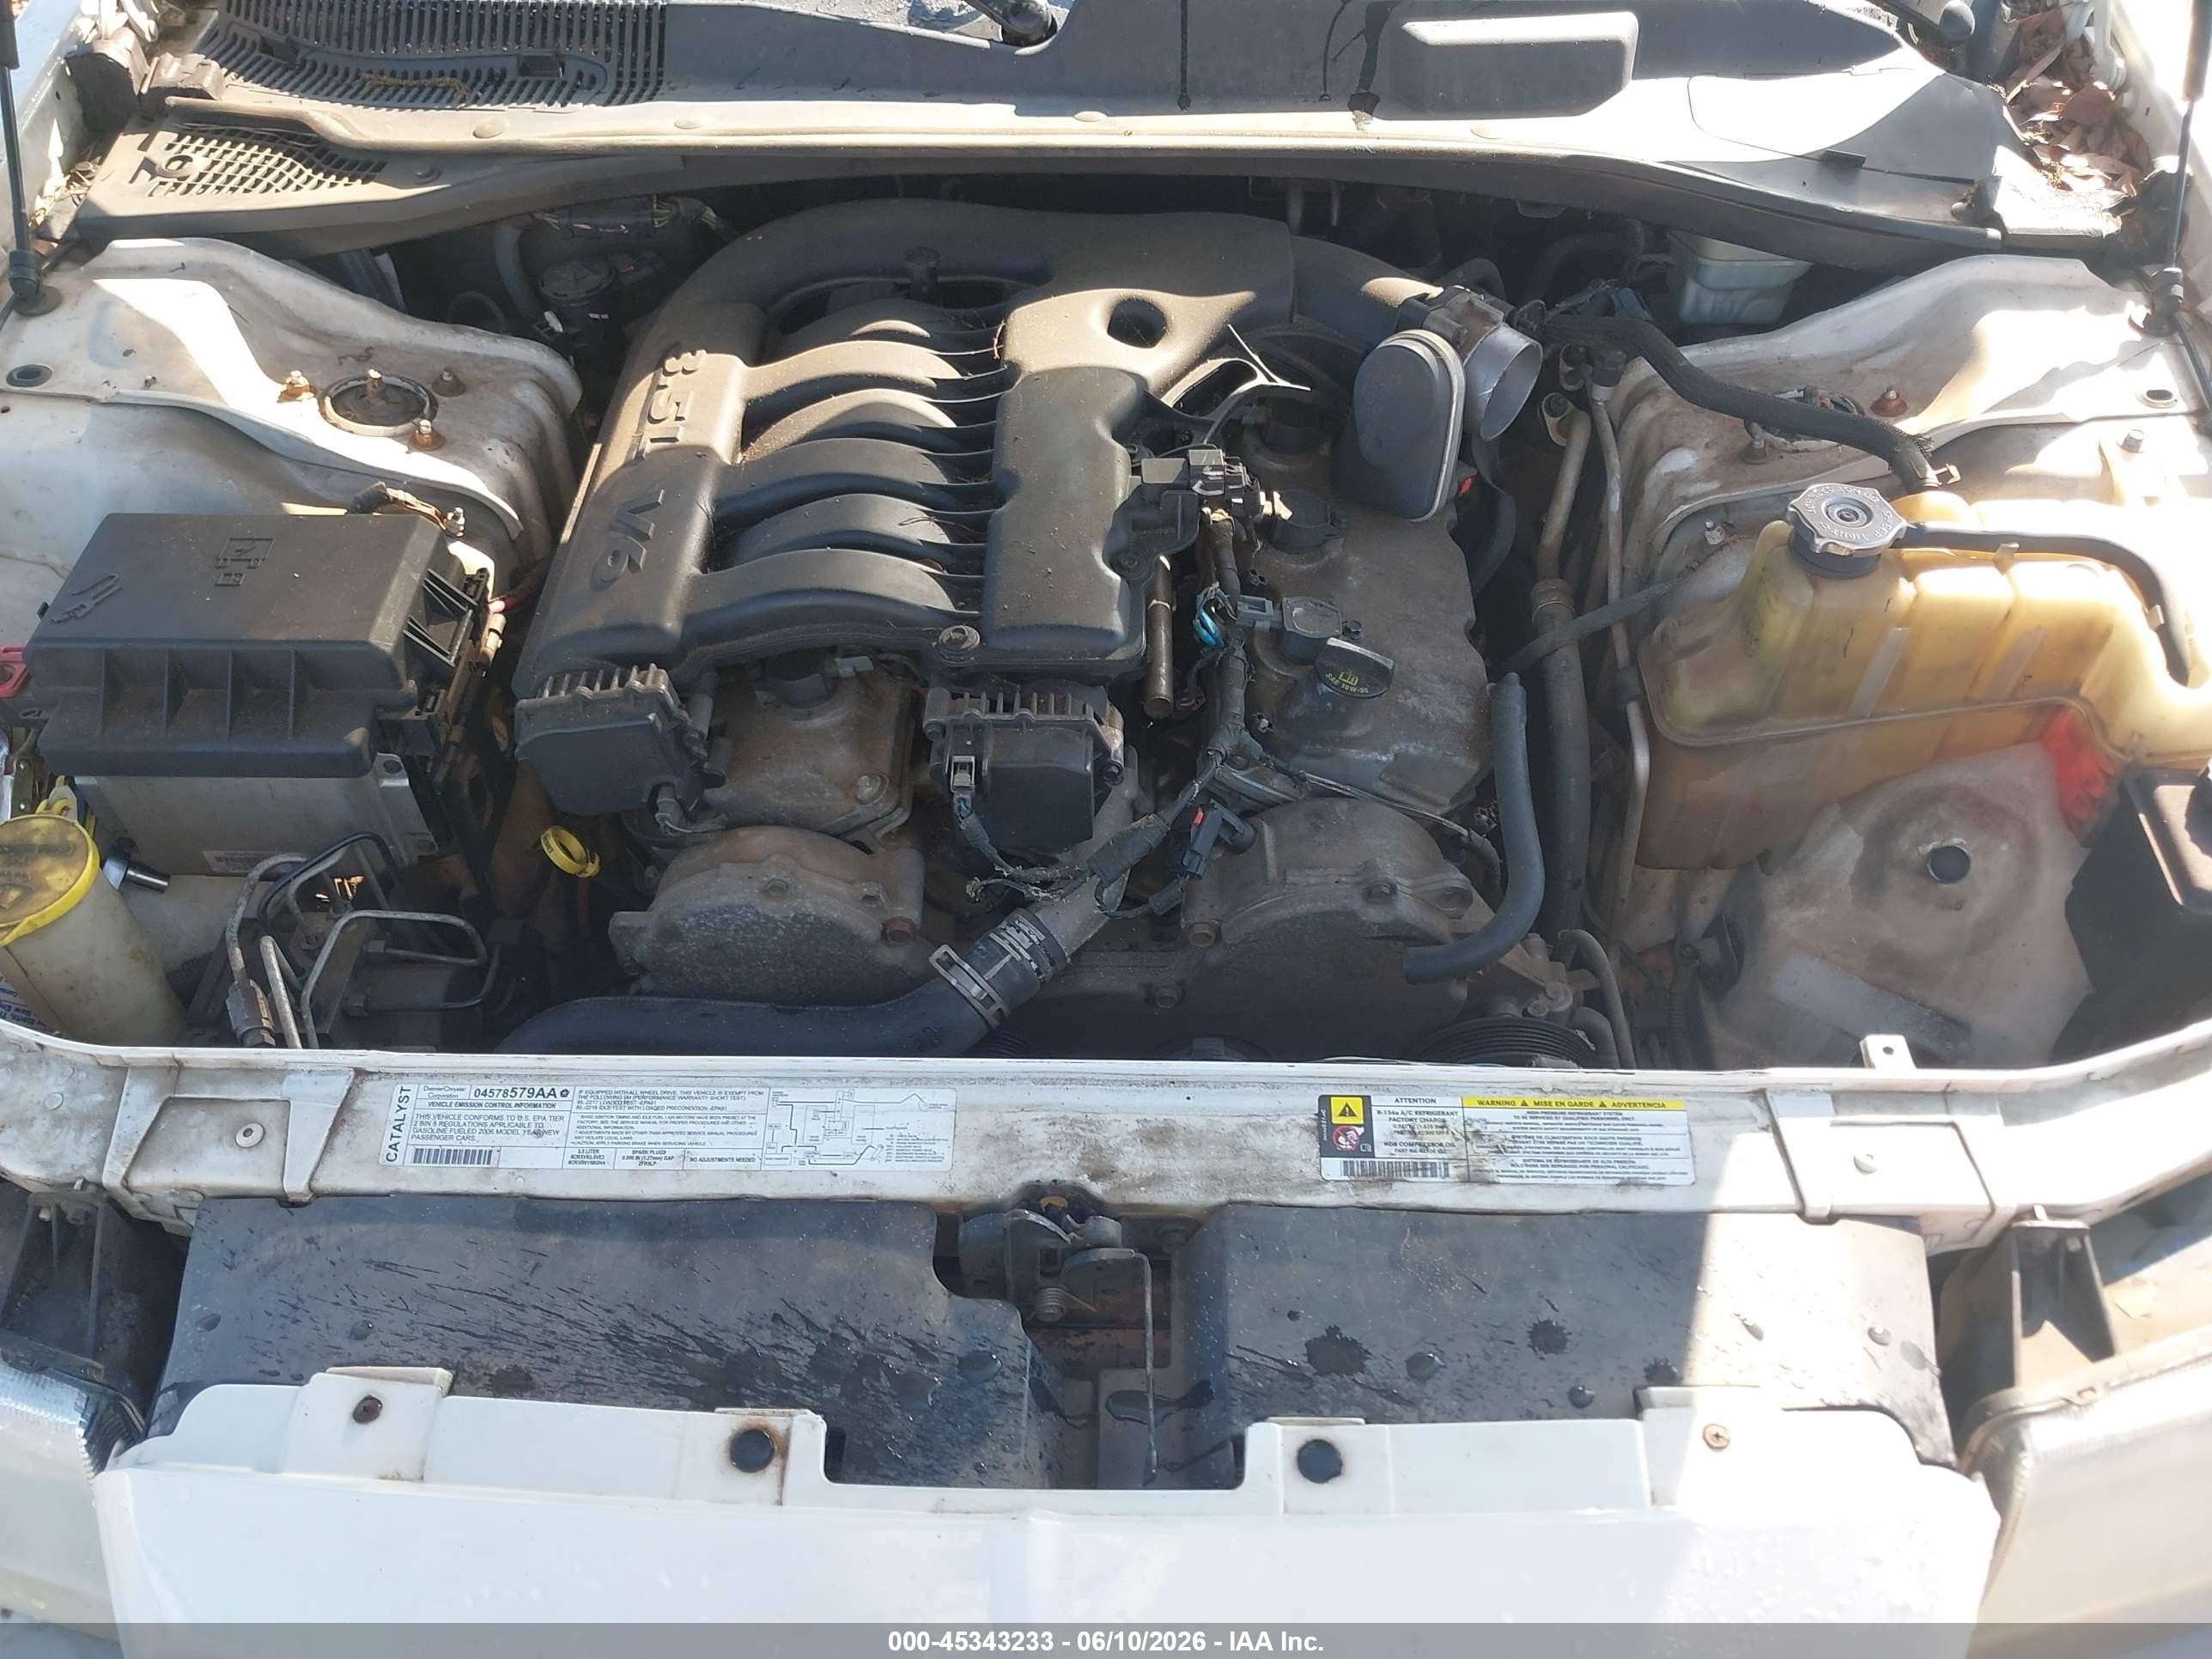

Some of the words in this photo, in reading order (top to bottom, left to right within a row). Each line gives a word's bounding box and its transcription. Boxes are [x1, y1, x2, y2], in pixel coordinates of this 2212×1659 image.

[590, 488, 665, 592] V6
[1325, 672, 1340, 686] SAE
[474, 1087, 557, 1098] 04578579AA
[386, 1085, 411, 1162] CATALYST
